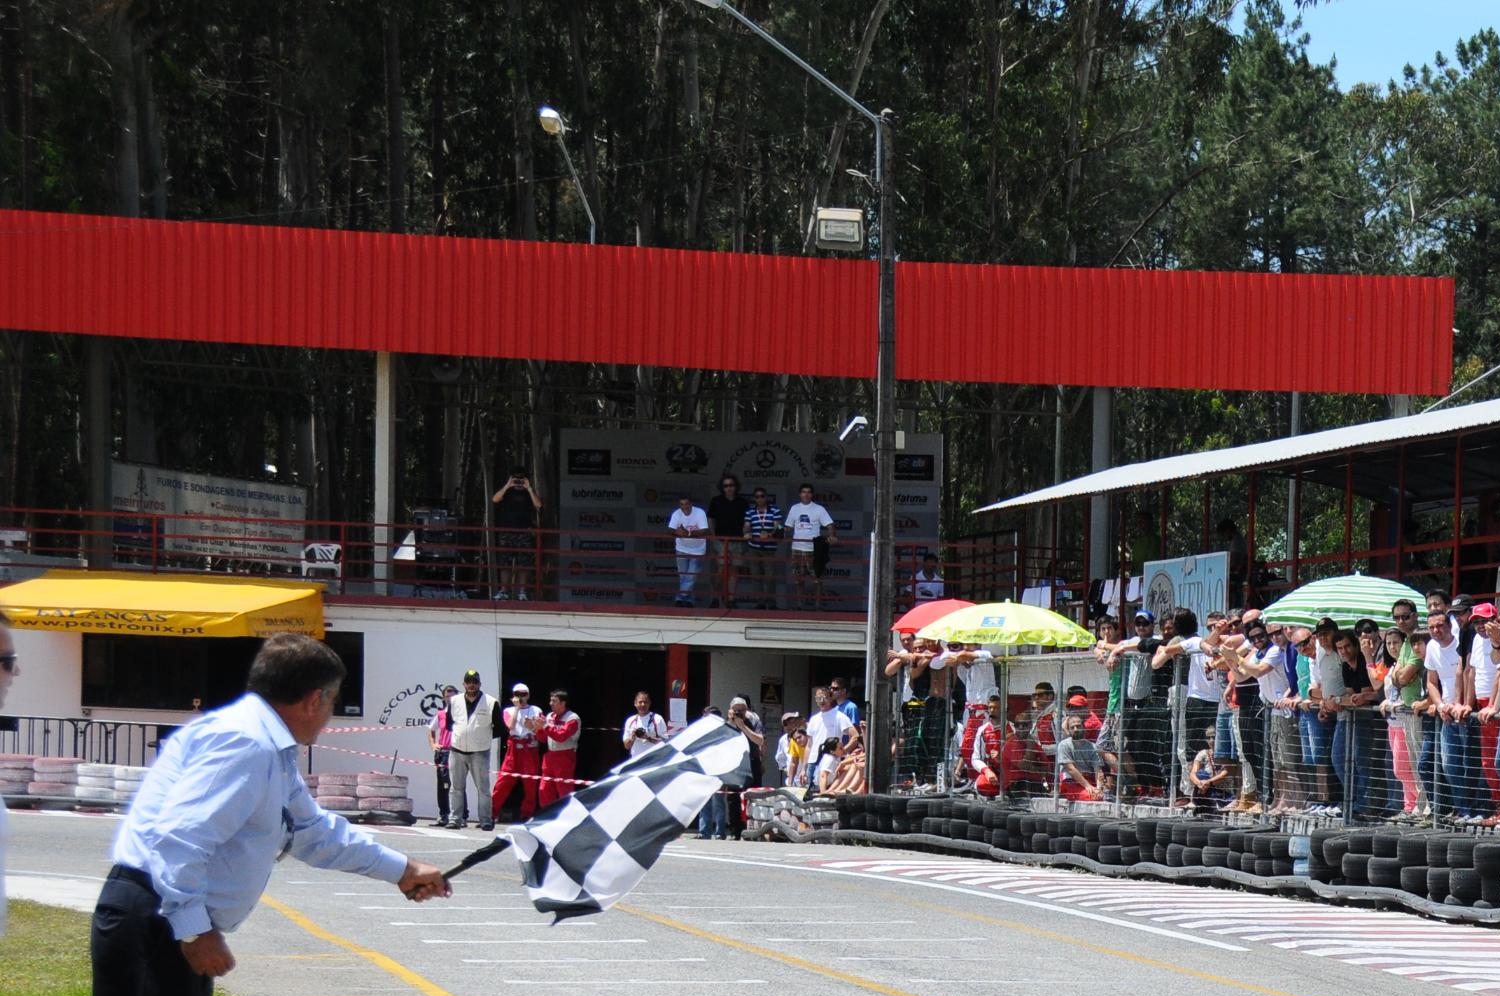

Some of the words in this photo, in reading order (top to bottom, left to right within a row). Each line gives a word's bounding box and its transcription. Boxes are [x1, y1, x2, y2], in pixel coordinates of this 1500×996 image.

[616, 458, 657, 466] HONDA
[157, 477, 183, 490] FUROS
[191, 481, 235, 497] SONDAGENS
[236, 488, 247, 498] DE
[263, 544, 288, 553] POMBAL
[14, 617, 205, 635] ww.pestronix.pt
[379, 684, 426, 725] ESCOLA
